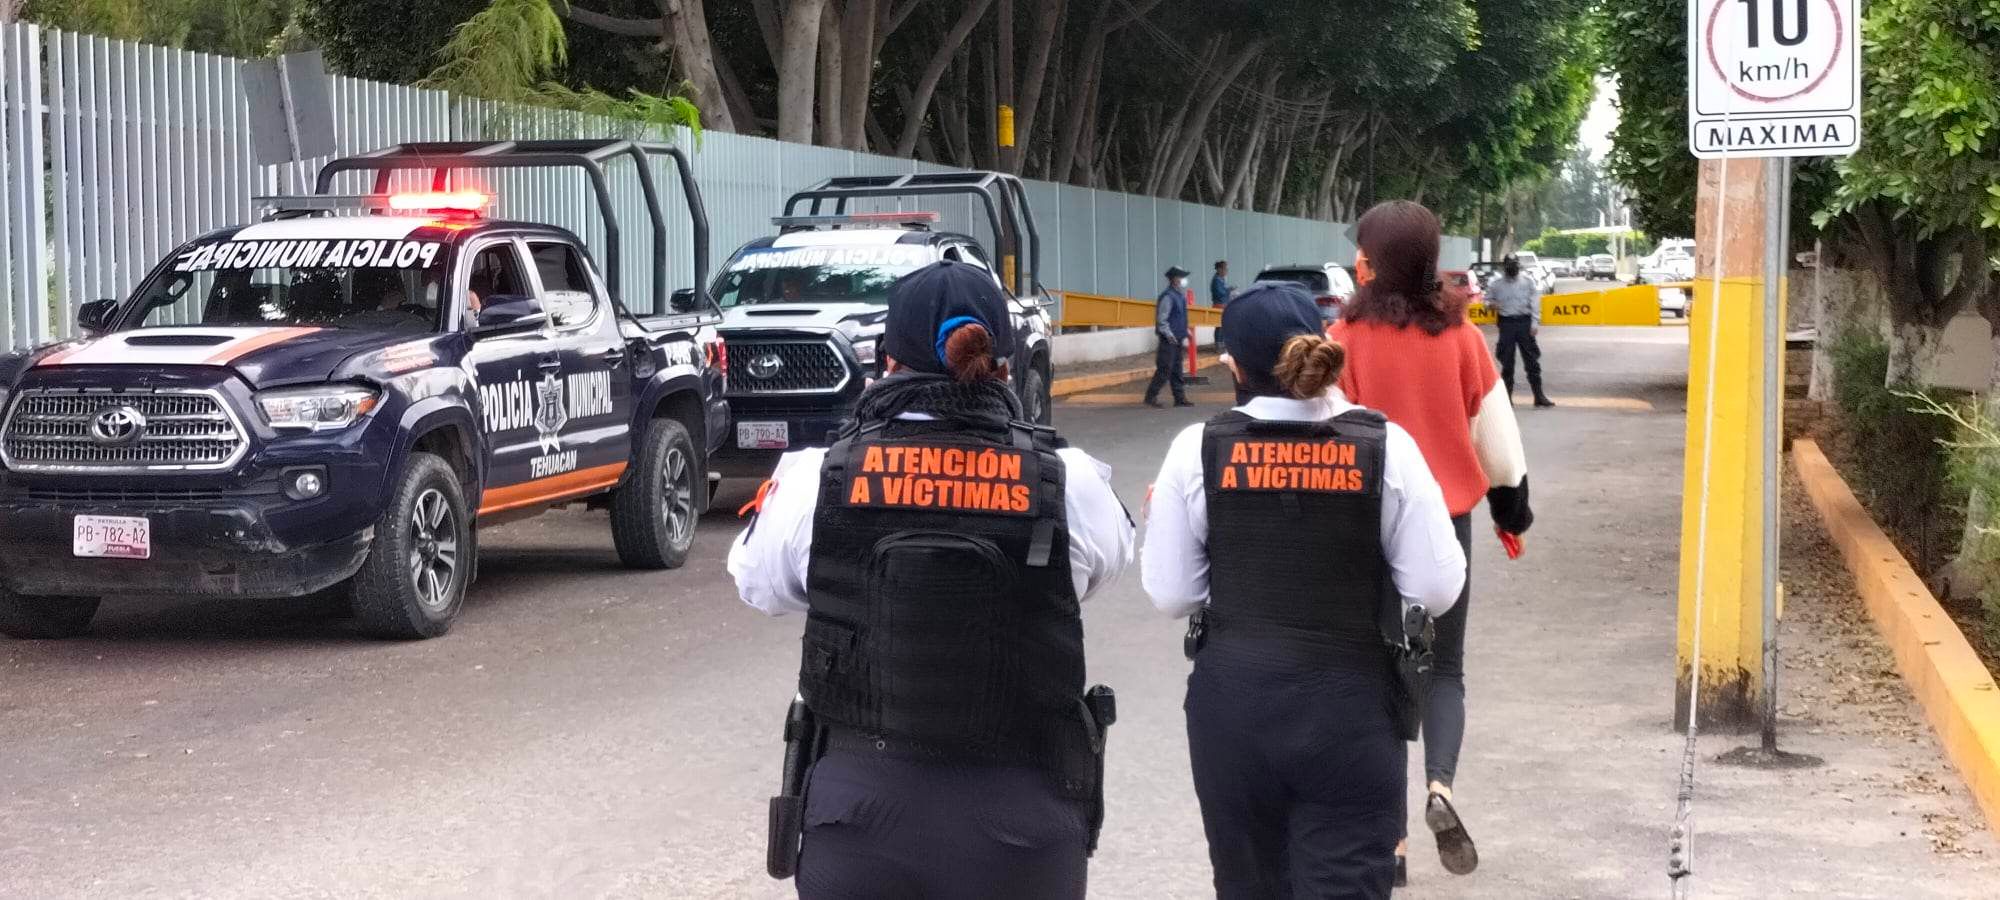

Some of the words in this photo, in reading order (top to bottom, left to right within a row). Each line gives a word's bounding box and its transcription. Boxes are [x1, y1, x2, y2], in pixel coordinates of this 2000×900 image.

[1738, 0, 1808, 48] 10
[1740, 57, 1808, 82] km/h
[1709, 123, 1840, 147] MAXIMA
[1552, 304, 1591, 316] ALTO
[480, 369, 533, 433] POLICÍA
[568, 370, 613, 419] MUNICIPAL
[530, 450, 577, 478] TEHUACAN
[863, 446, 1022, 480] ATENCIÓN
[1230, 440, 1356, 466] ATENCIÓN
[1221, 466, 1238, 488] A
[1246, 463, 1363, 491] VÍCTIMAS
[850, 476, 870, 504] A
[882, 473, 1030, 512] VÍCTIMAS
[78, 525, 146, 544] PB-782-A2
